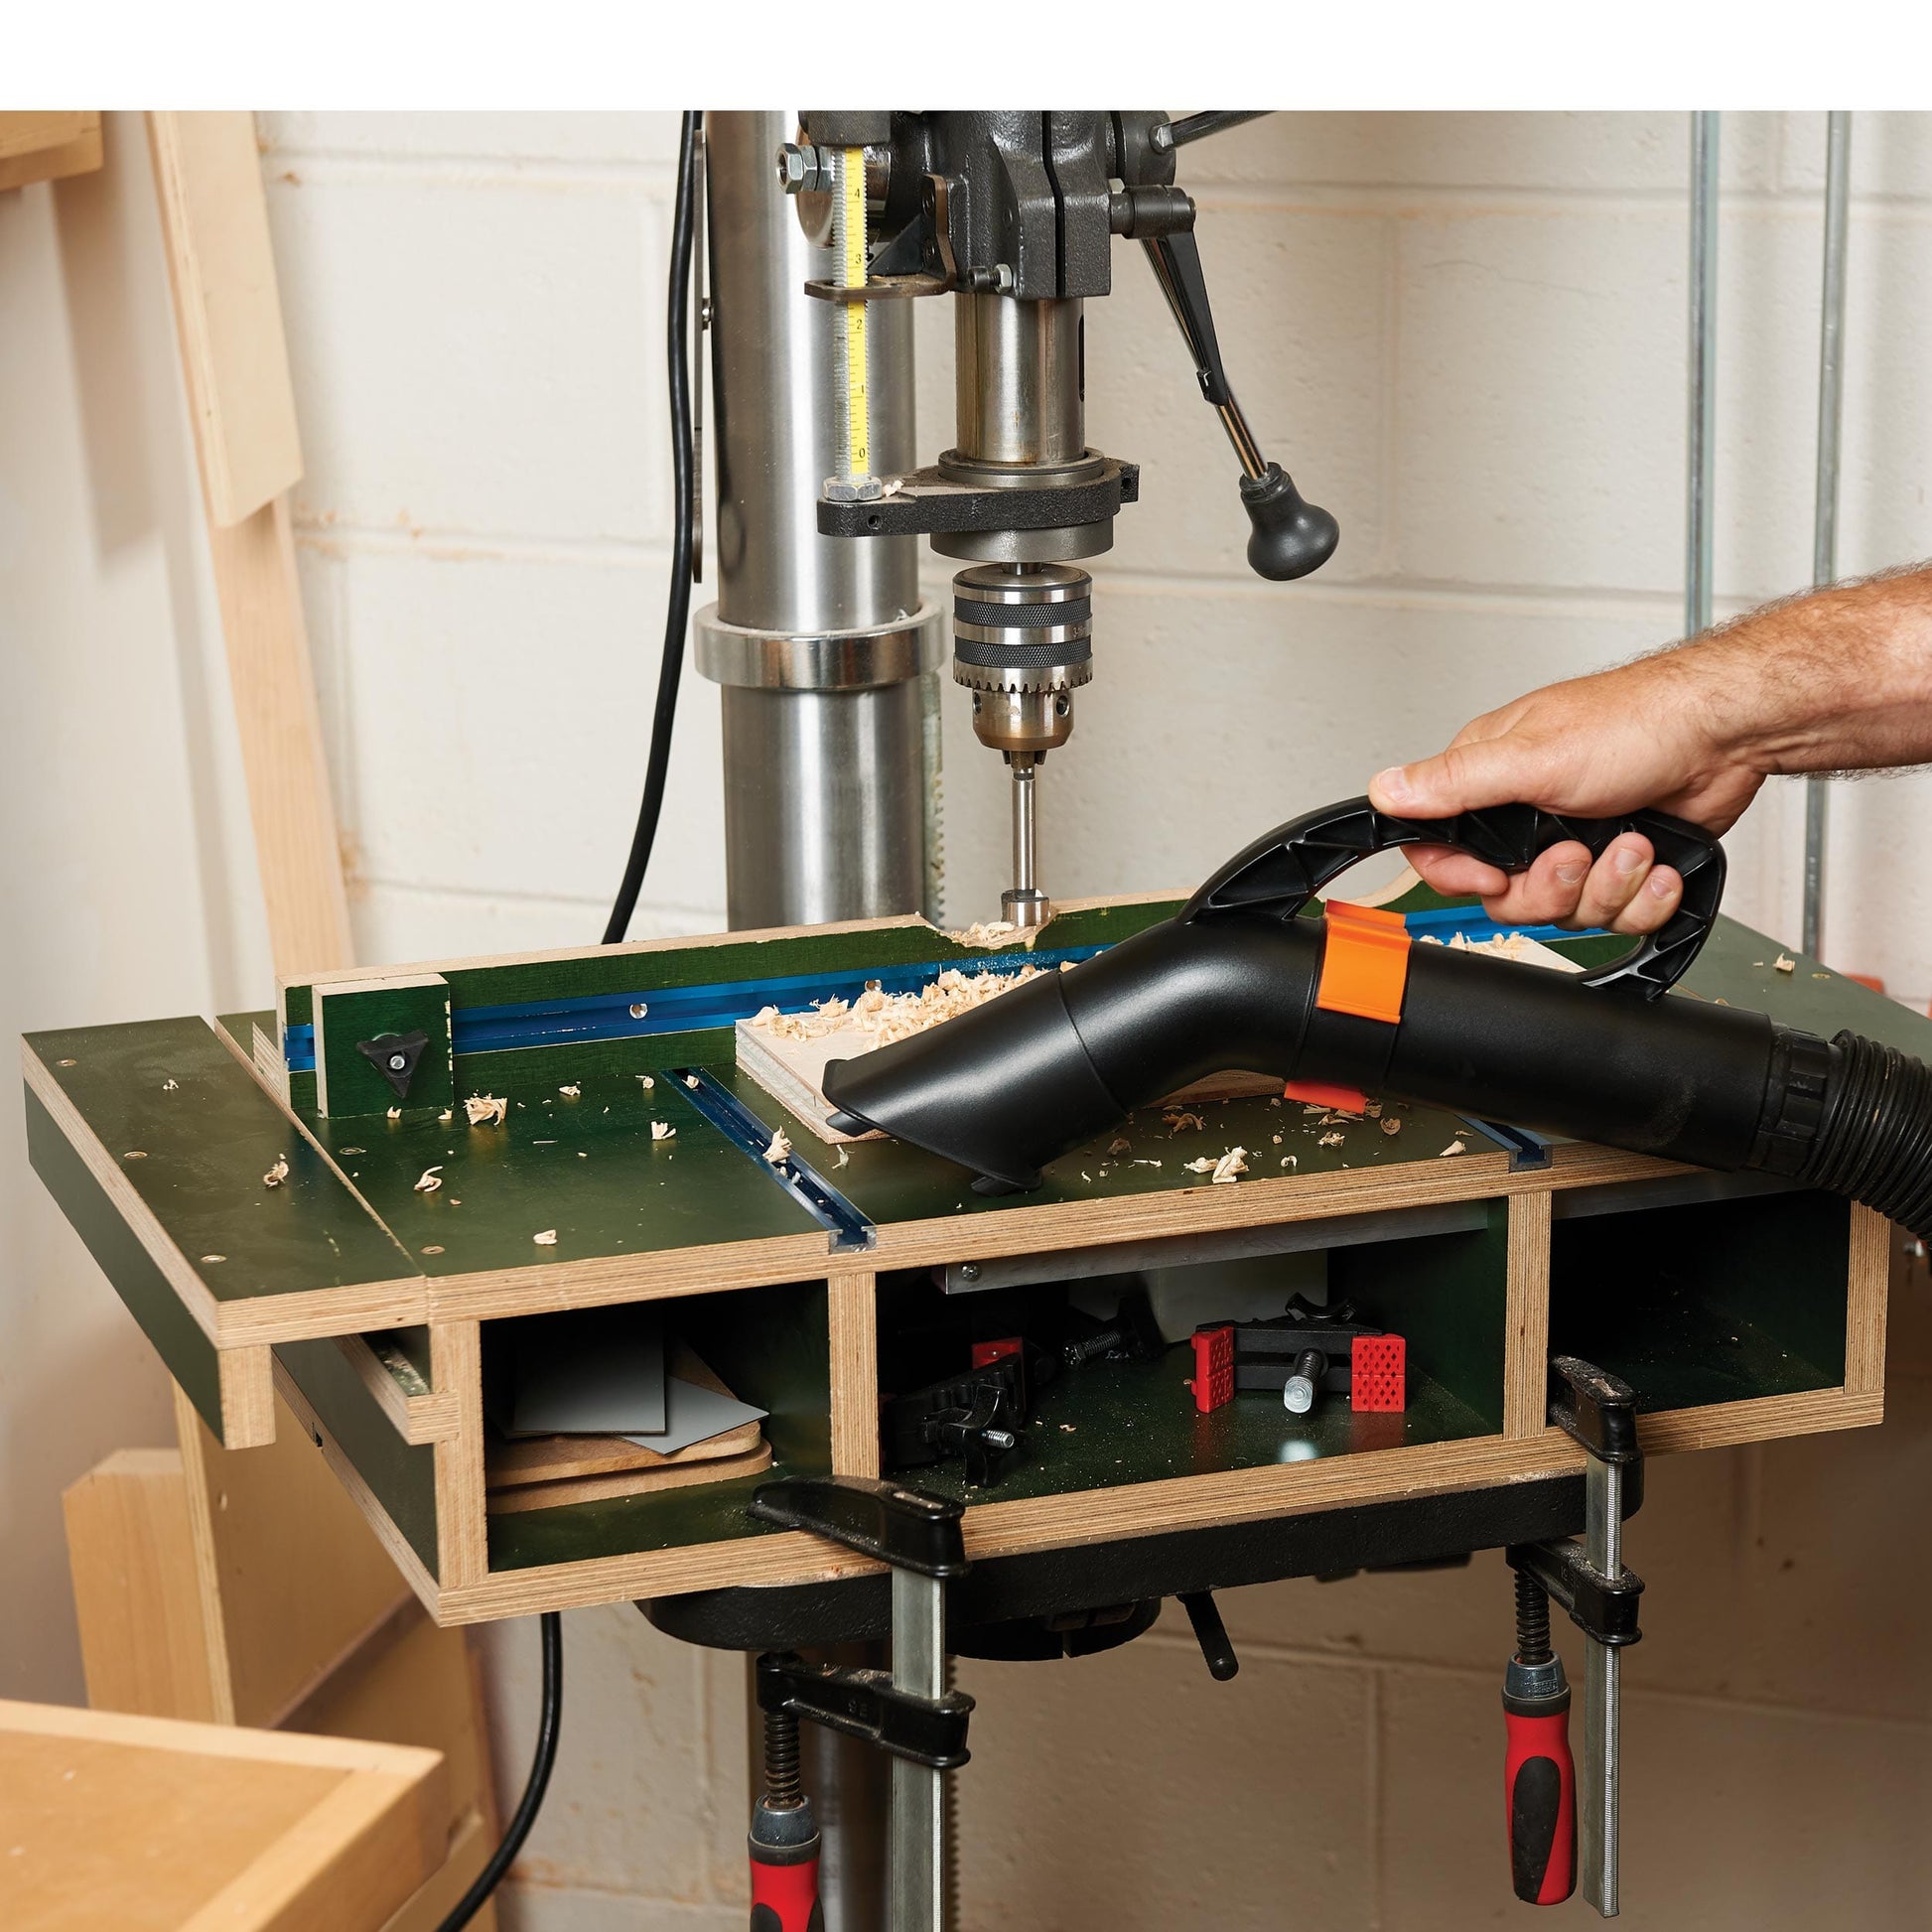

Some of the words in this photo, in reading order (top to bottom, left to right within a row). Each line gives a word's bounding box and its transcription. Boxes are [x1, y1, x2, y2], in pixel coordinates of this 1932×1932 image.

[854, 188, 861, 199] 4
[855, 253, 862, 265] 3
[856, 319, 863, 330] 2
[859, 448, 866, 459] 0
